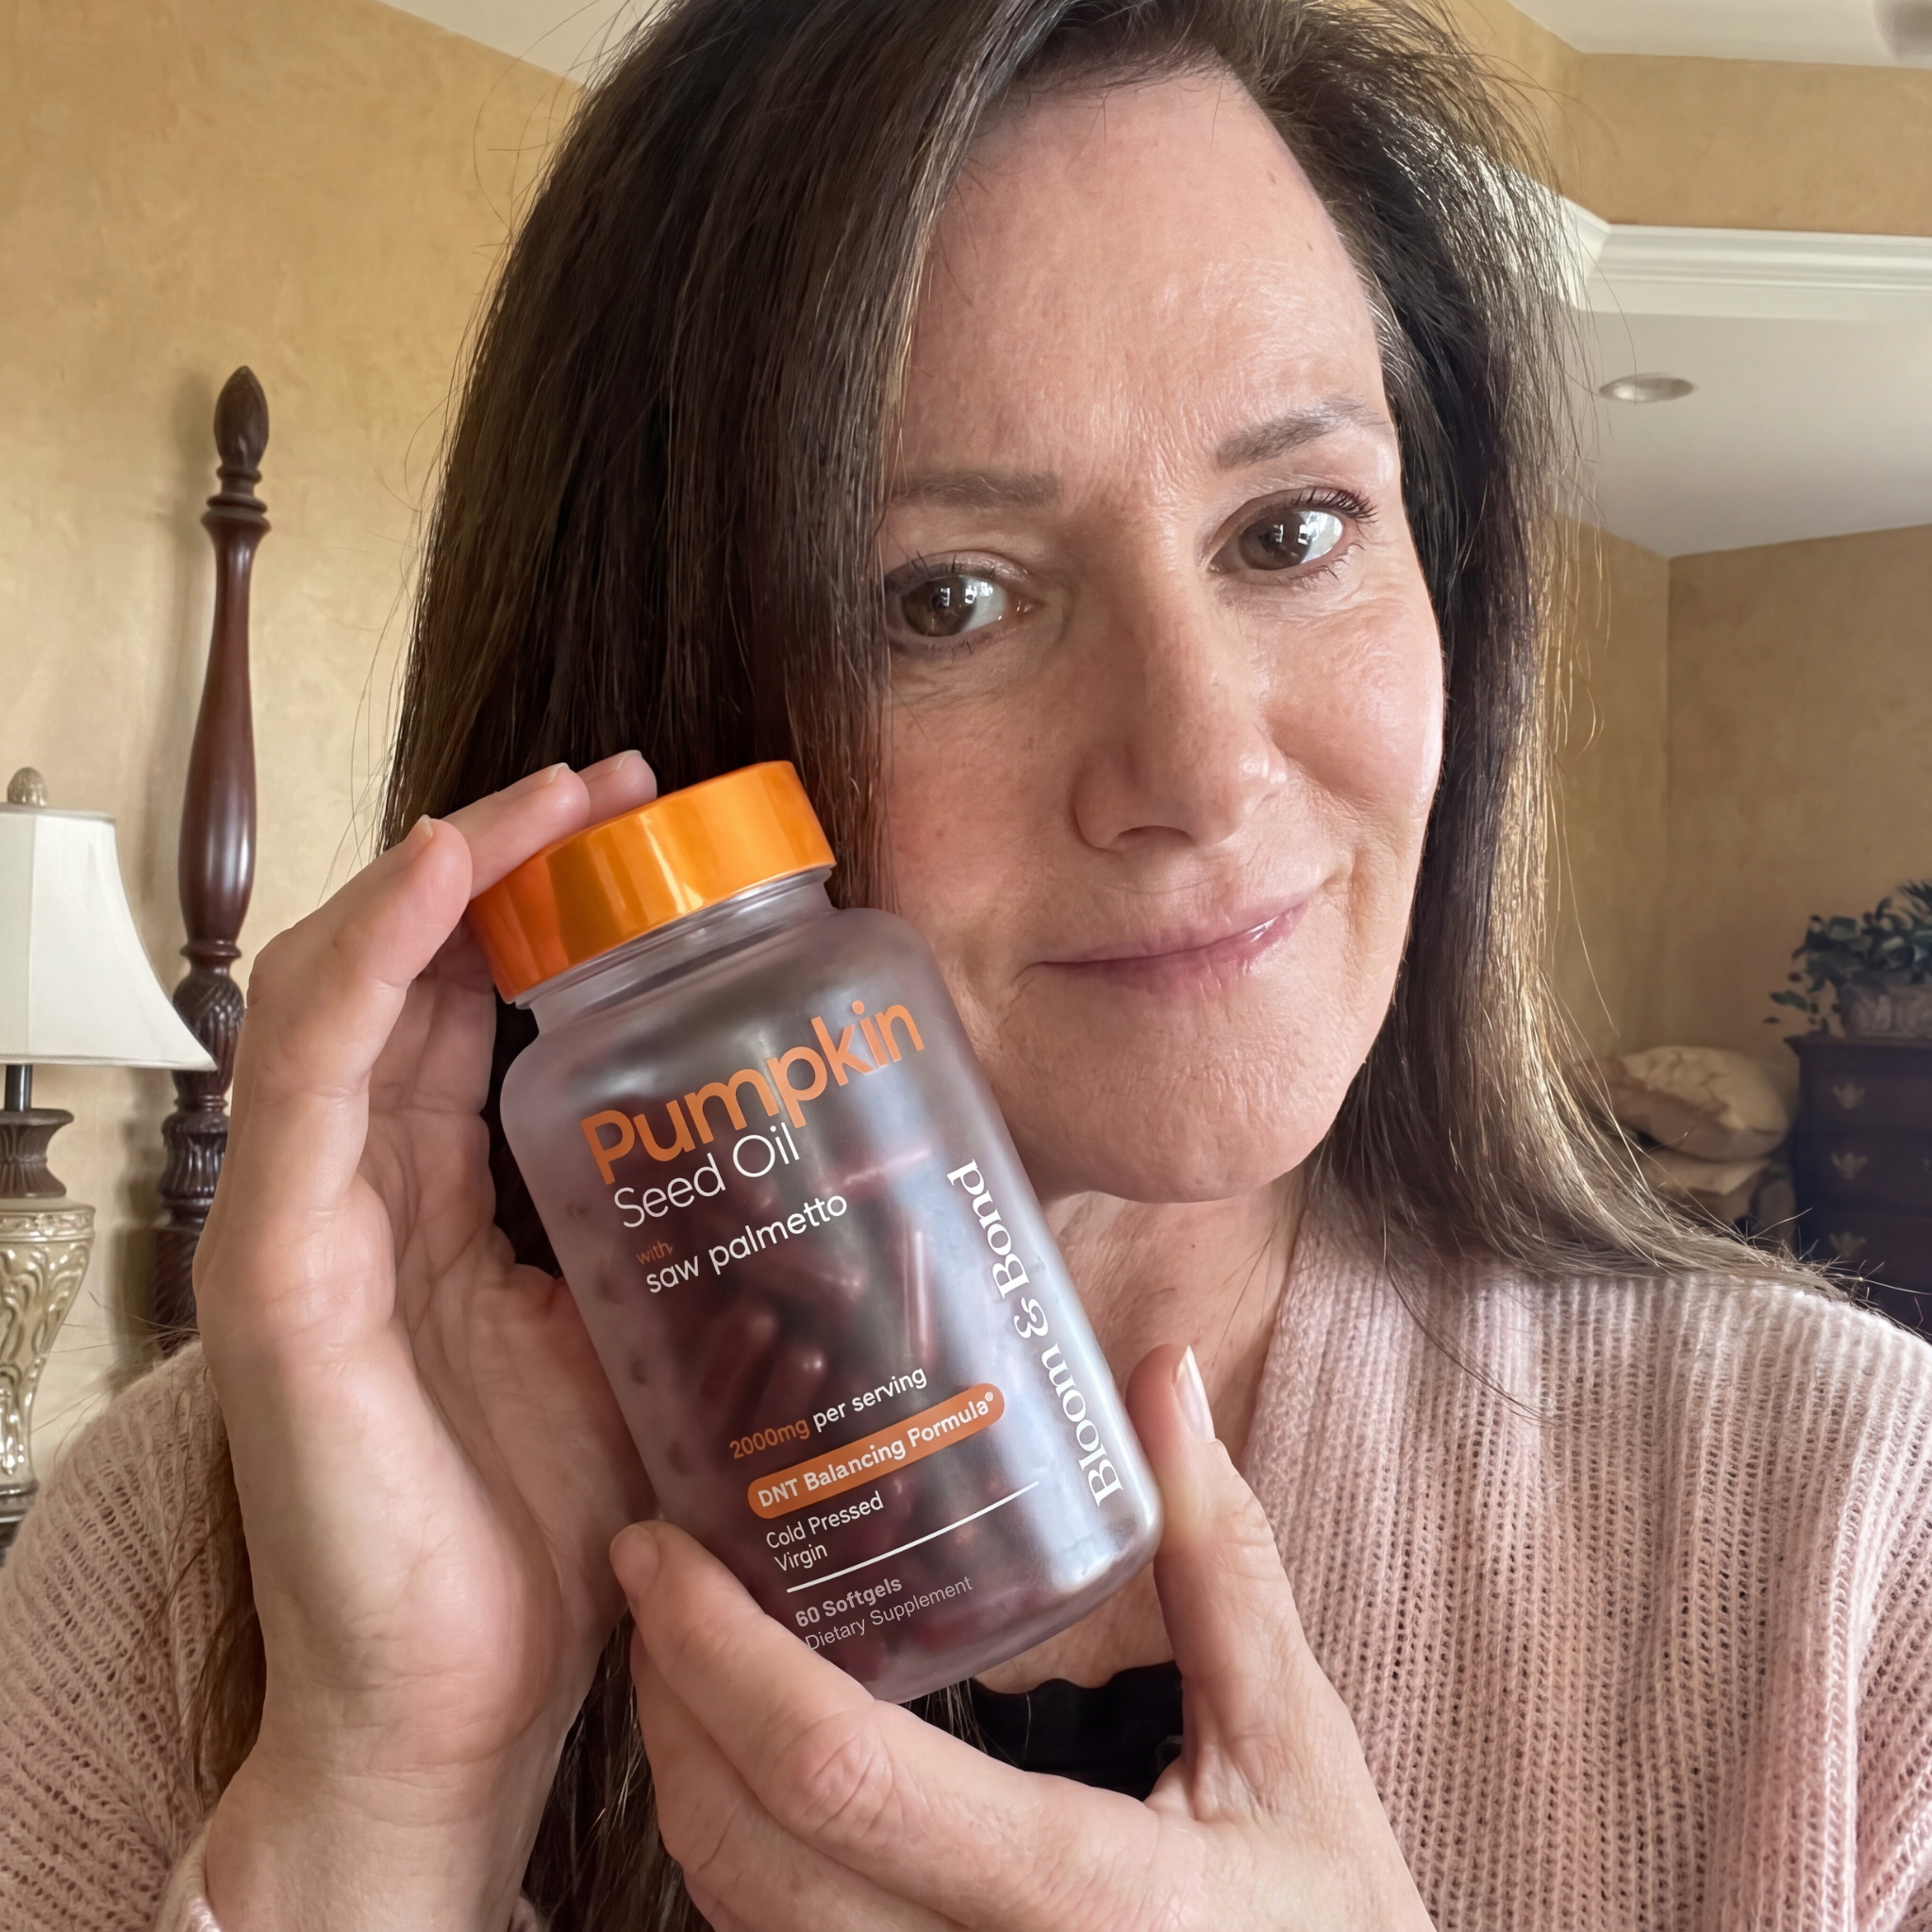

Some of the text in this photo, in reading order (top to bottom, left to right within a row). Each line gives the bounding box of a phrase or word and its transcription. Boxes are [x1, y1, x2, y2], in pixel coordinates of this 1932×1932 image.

[580, 1000, 924, 1185] Pumpkin
[614, 1122, 800, 1227] Seed Oil
[636, 1241, 674, 1265] with
[646, 1194, 847, 1293] saw palmetto
[946, 1158, 1124, 1507] Bloom & Bond
[729, 1368, 927, 1458] 2000mg per serving
[757, 1478, 800, 1507] DNT
[803, 1439, 906, 1492] Balancing
[766, 1490, 884, 1549] Cold Pressed
[774, 1542, 827, 1572] Virgin
[795, 1578, 903, 1627] 60 Softgels
[805, 1575, 973, 1651] Dietary Supplement
